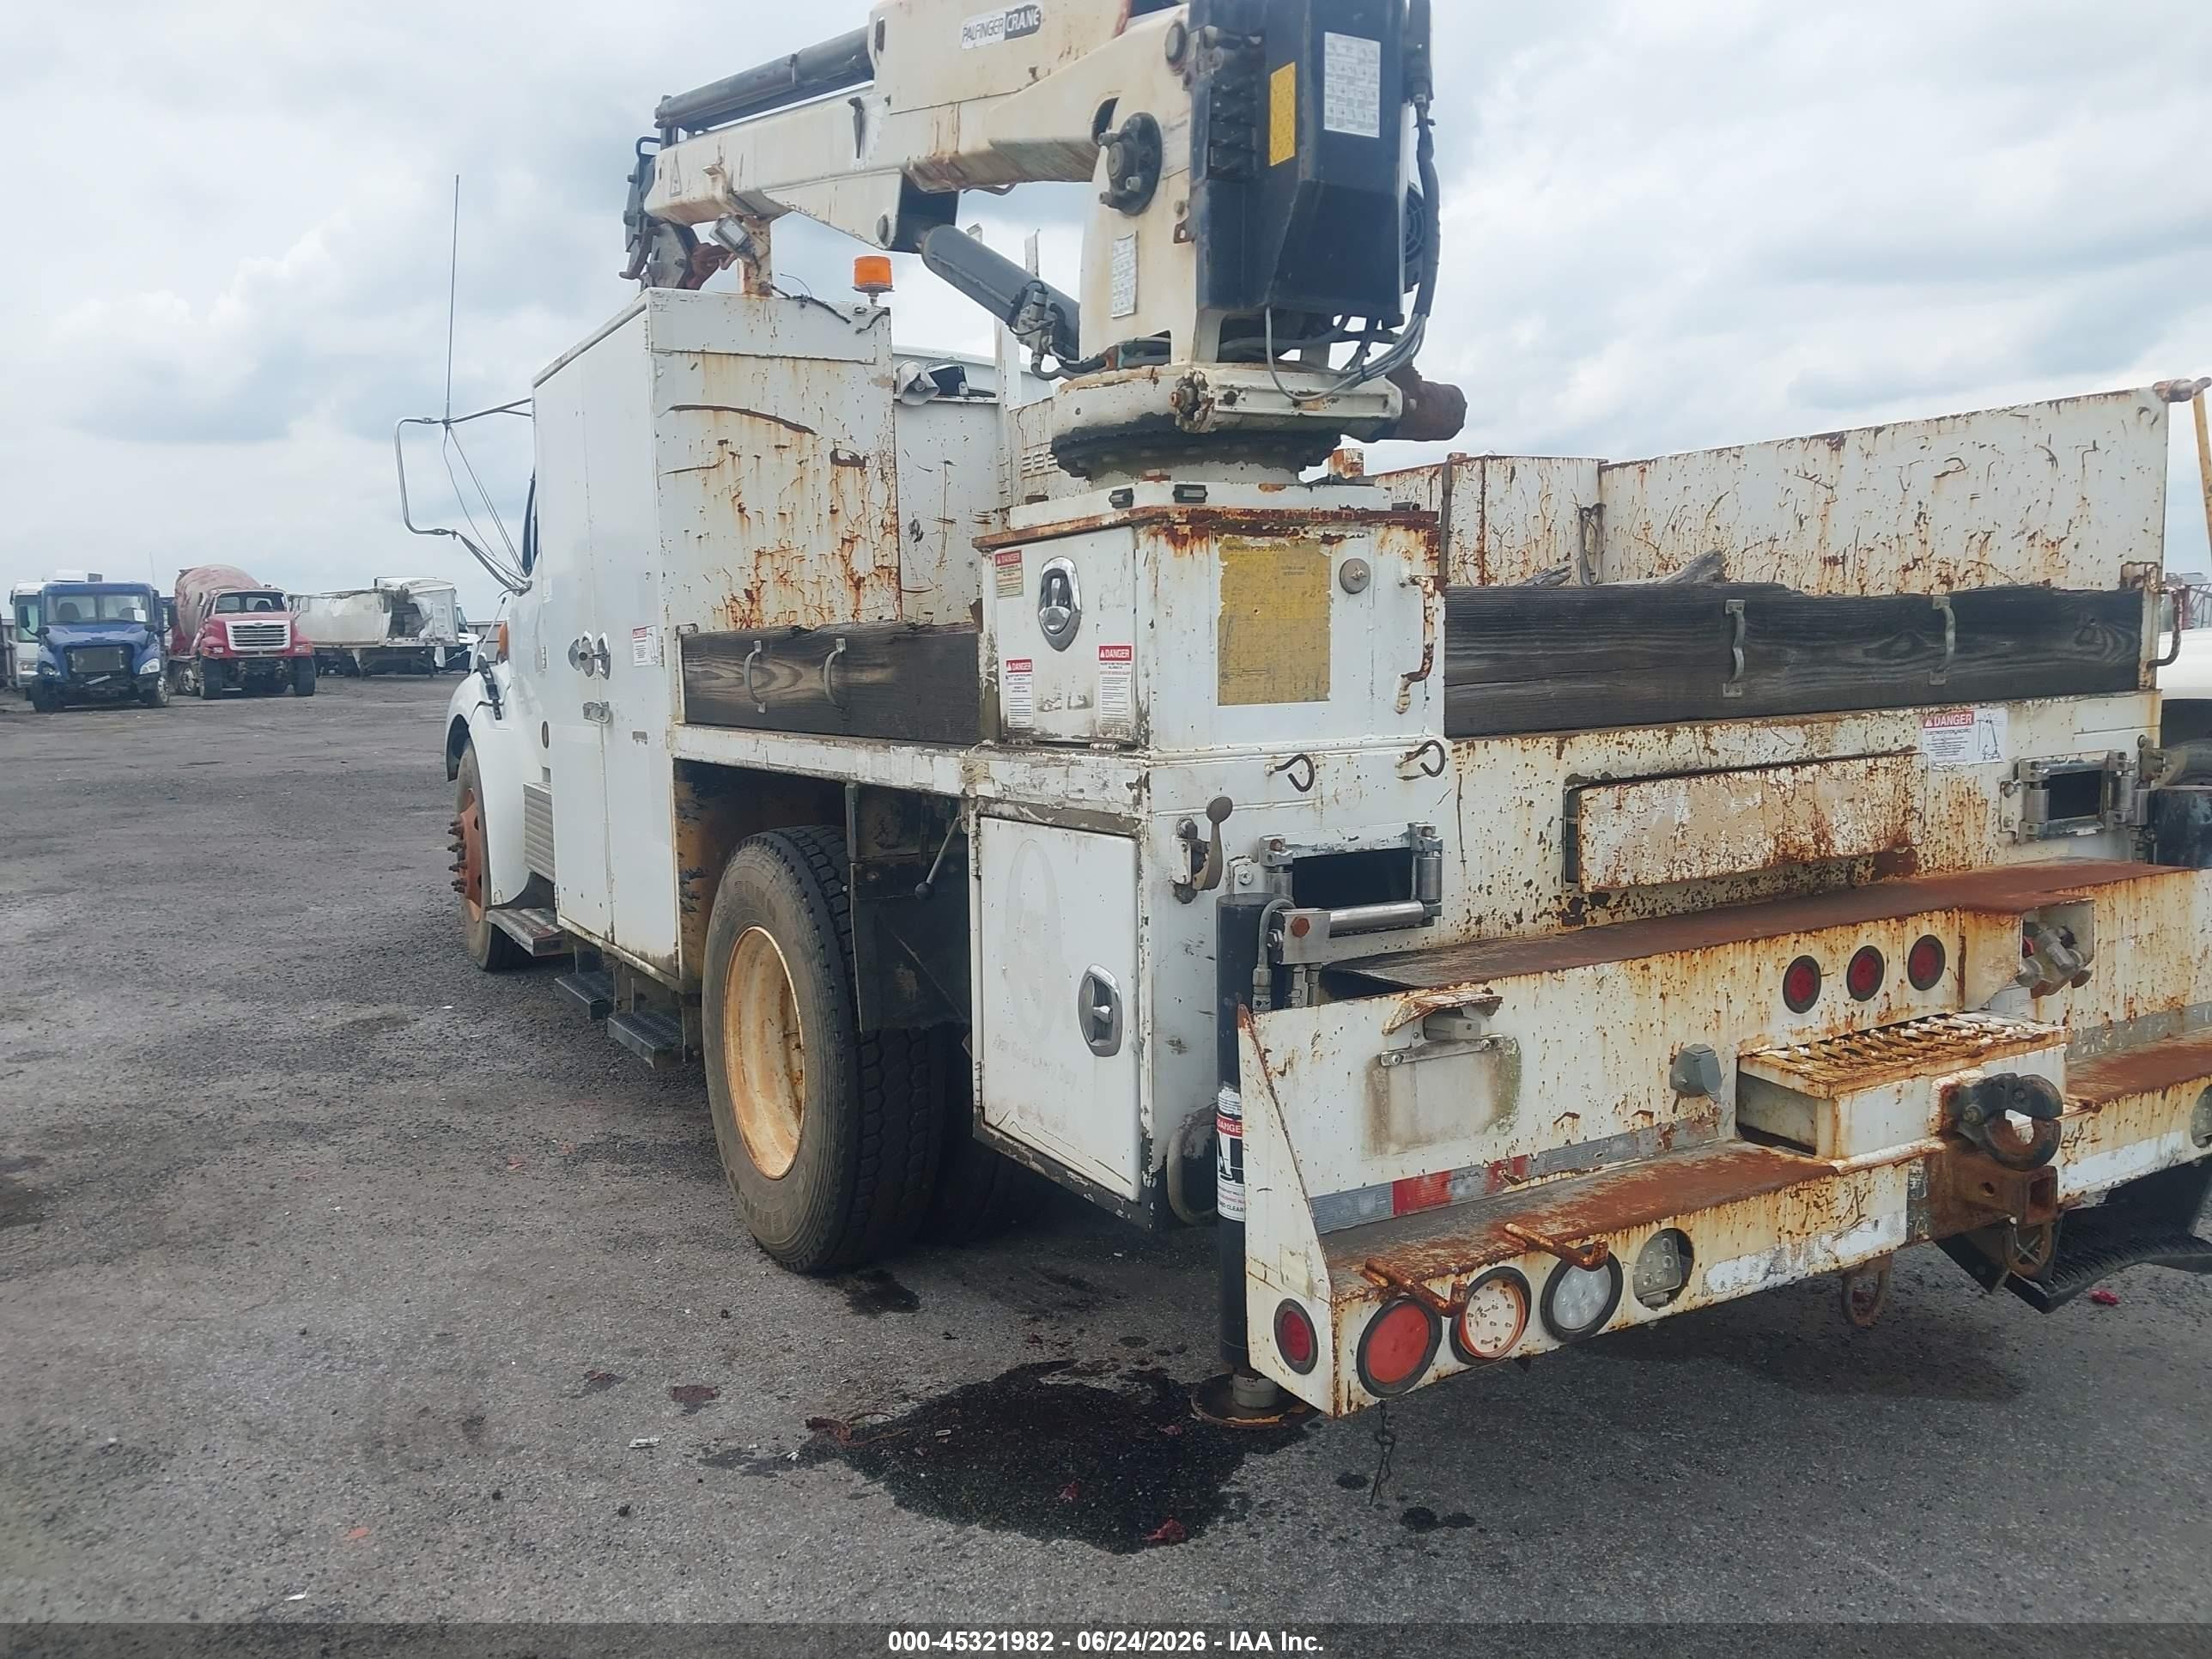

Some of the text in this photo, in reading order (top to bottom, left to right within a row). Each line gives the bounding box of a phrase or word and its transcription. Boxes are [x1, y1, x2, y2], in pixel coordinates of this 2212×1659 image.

[963, 8, 1040, 43] PALFINGER CRANE
[1105, 648, 1130, 659] DANGER
[1934, 714, 1972, 726] DANGER
[1217, 1119, 1242, 1133] DANGE
